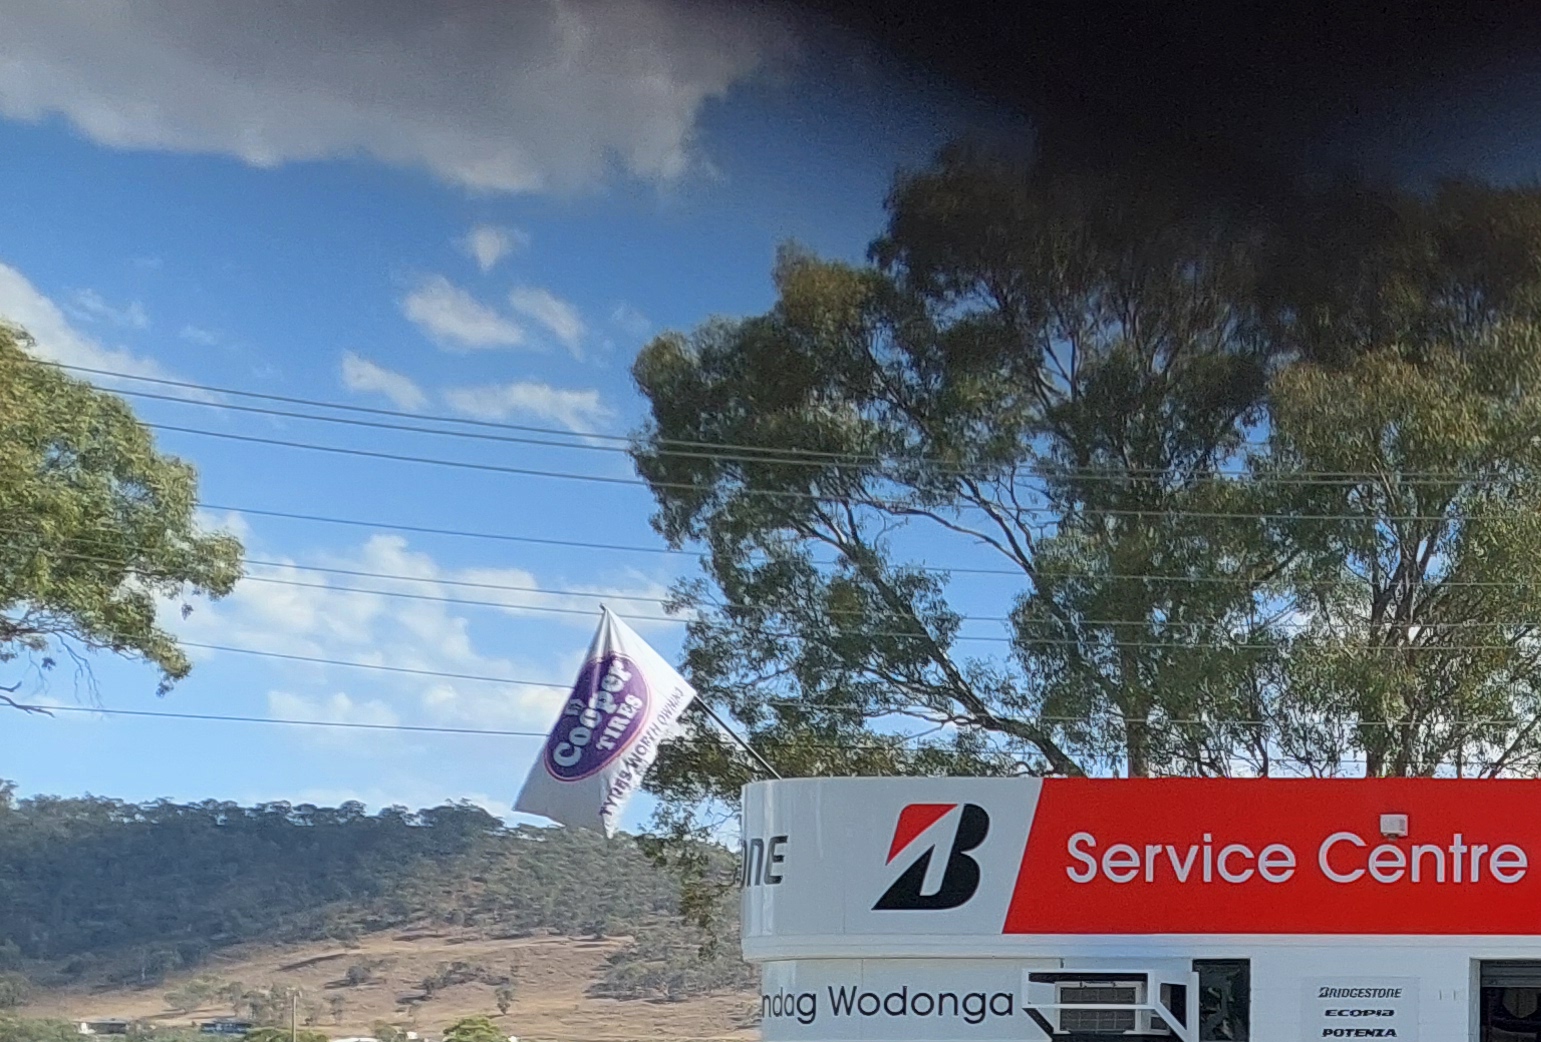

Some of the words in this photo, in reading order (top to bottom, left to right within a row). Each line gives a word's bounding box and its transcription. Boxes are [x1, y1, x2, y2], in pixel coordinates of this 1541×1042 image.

[553, 659, 632, 767] Cooper
[596, 693, 643, 751] TIRES
[626, 724, 664, 771] WORTH
[1065, 831, 1296, 883] Service
[1318, 831, 1528, 883] Centre
[828, 985, 1014, 1025] Wodonga
[1318, 987, 1403, 999] BRIDGESTONE
[1324, 1009, 1395, 1017] ECOPIA
[1321, 1028, 1398, 1038] POTENZA
